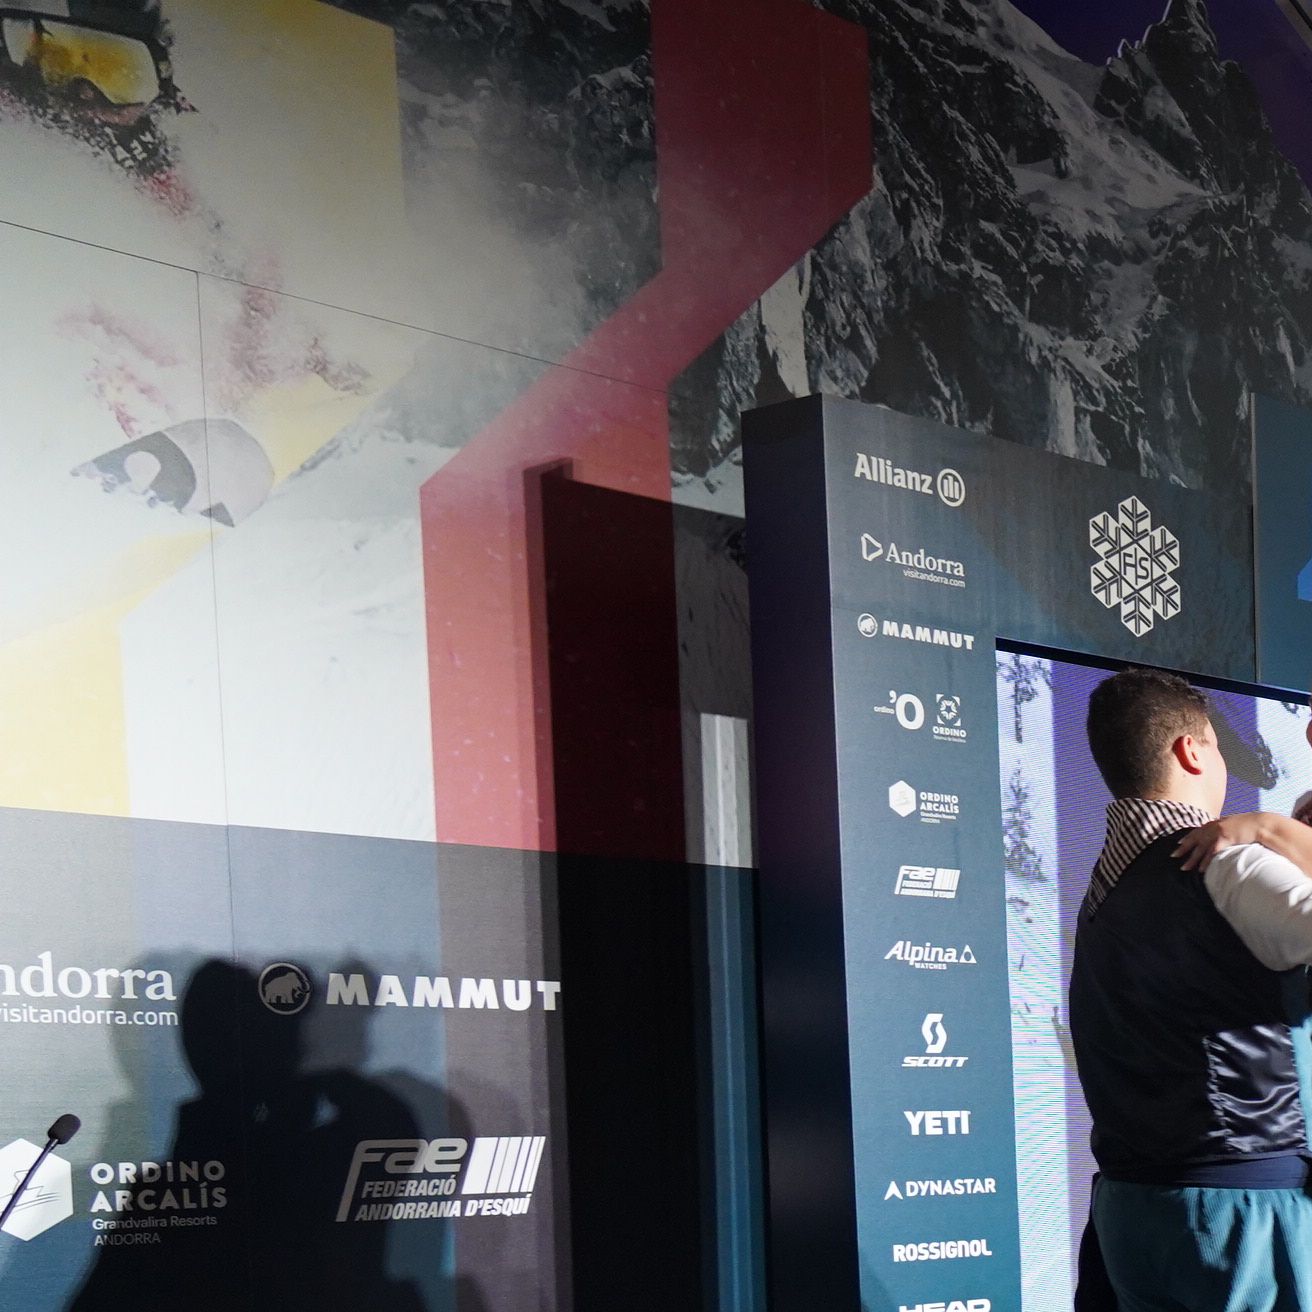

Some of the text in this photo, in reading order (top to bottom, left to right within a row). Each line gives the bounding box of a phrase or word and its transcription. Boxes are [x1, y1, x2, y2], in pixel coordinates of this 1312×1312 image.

[854, 453, 934, 495] Allianz
[885, 543, 965, 577] Andorra
[903, 569, 966, 588] visitandorra.com
[882, 620, 975, 650] MAMMUT
[932, 725, 968, 738] ORDINO
[919, 791, 959, 804] ORDINO
[919, 801, 960, 814] ARCALÍS
[884, 940, 959, 966] Alpina
[0, 951, 177, 1000] ndorra
[325, 973, 562, 1011] MAMMUT
[901, 1056, 969, 1068] SCOTT
[904, 1110, 971, 1136] YETI
[90, 1161, 226, 1185] ORDINO
[90, 1181, 228, 1213] ARCALÍS
[361, 1175, 457, 1199] FEDERACIÓ
[905, 1177, 997, 1197] DYNASTAR
[355, 1194, 533, 1222] ANDORRANA D'ESQUÍ
[92, 1215, 218, 1231] Grandvalira Resorts
[94, 1232, 161, 1247] ANDORRA
[892, 1239, 993, 1263] ROSSIGNOL
